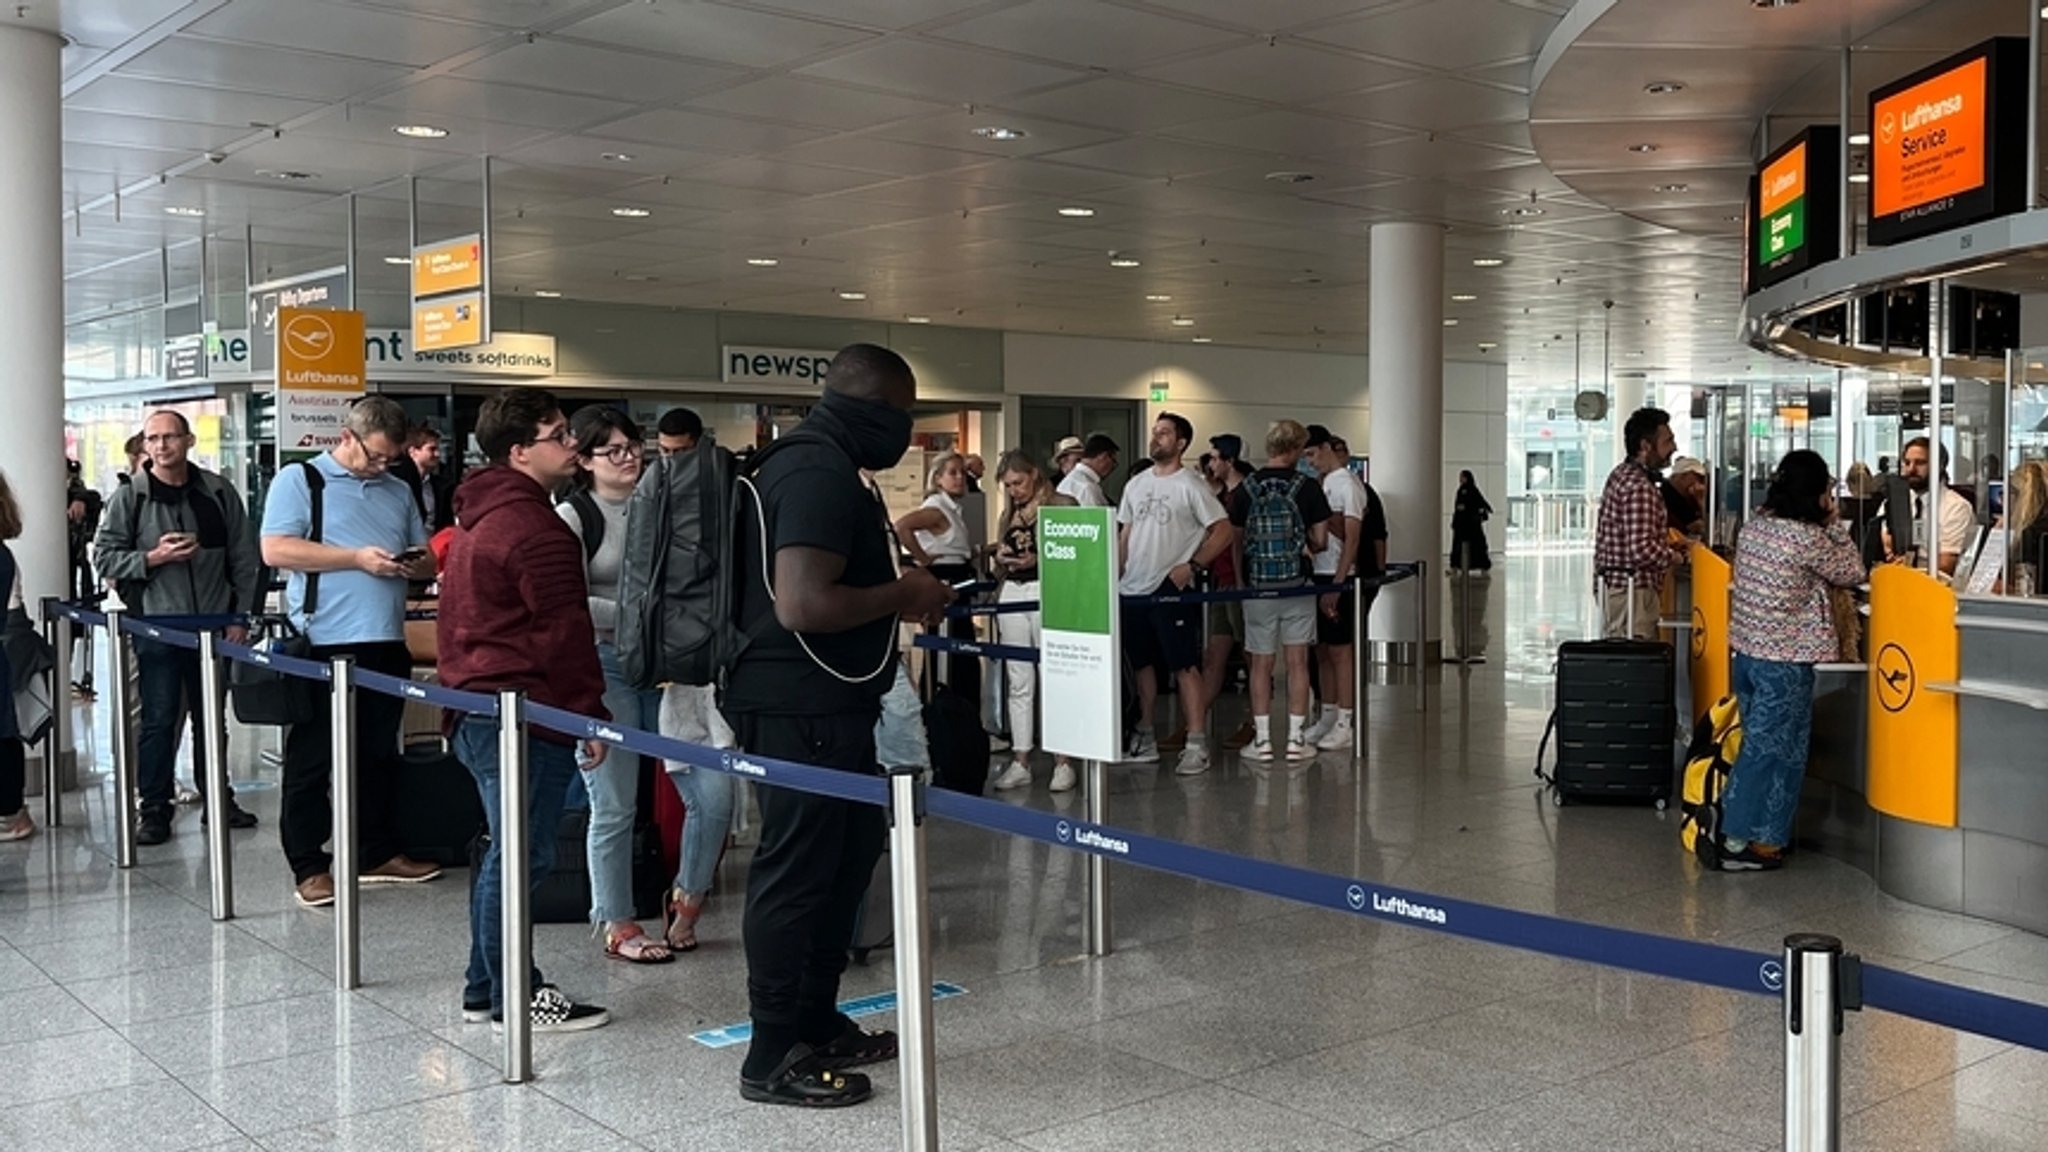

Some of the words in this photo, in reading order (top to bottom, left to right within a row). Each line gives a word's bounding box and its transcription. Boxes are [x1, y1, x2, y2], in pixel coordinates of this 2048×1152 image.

[1902, 94, 1962, 132] Lufthansa
[1901, 128, 1947, 158] Service
[415, 350, 473, 364] sweets
[477, 351, 552, 368] softdrinks
[731, 353, 832, 385] newsp
[285, 369, 359, 385] Lufthansa
[288, 394, 339, 406] Austrian
[290, 413, 337, 423] brussels
[1044, 518, 1100, 543] Economy
[1044, 540, 1077, 559] Class
[1075, 827, 1129, 853] Lufthansa
[1373, 891, 1446, 925] Lufthansa
